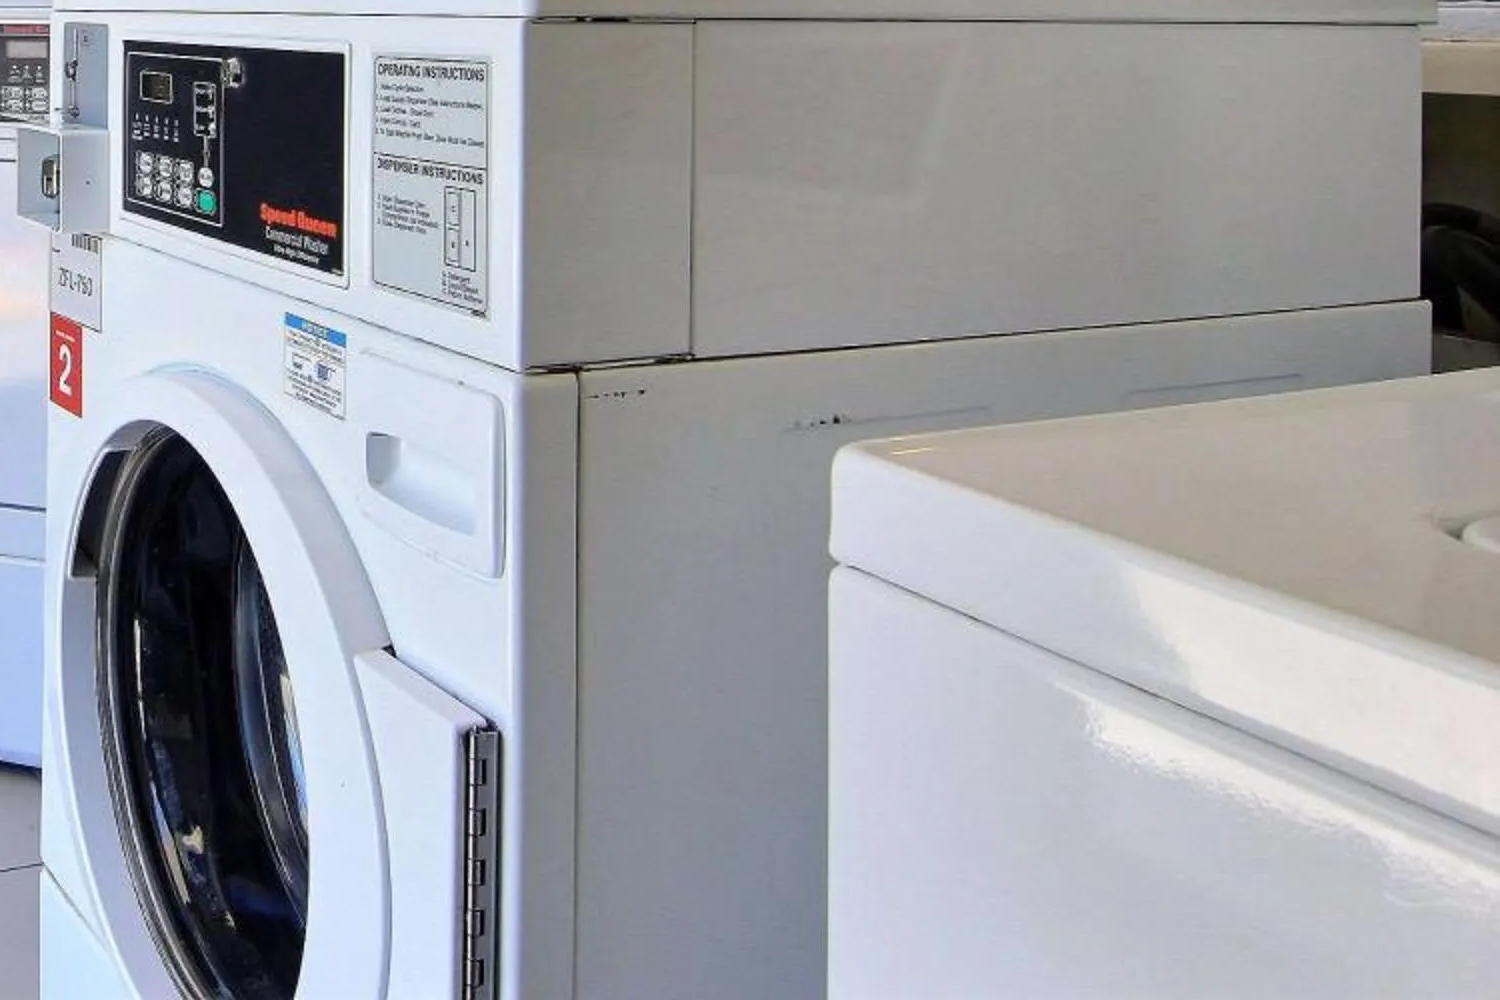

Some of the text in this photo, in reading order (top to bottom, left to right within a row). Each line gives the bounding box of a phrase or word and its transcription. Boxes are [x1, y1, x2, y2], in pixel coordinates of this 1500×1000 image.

[377, 63, 485, 82] OPERATING INSTRUCTIONS
[421, 165, 484, 185] INSTRUCTIONS
[259, 202, 337, 239] Speed Queen
[58, 343, 73, 397] 2
